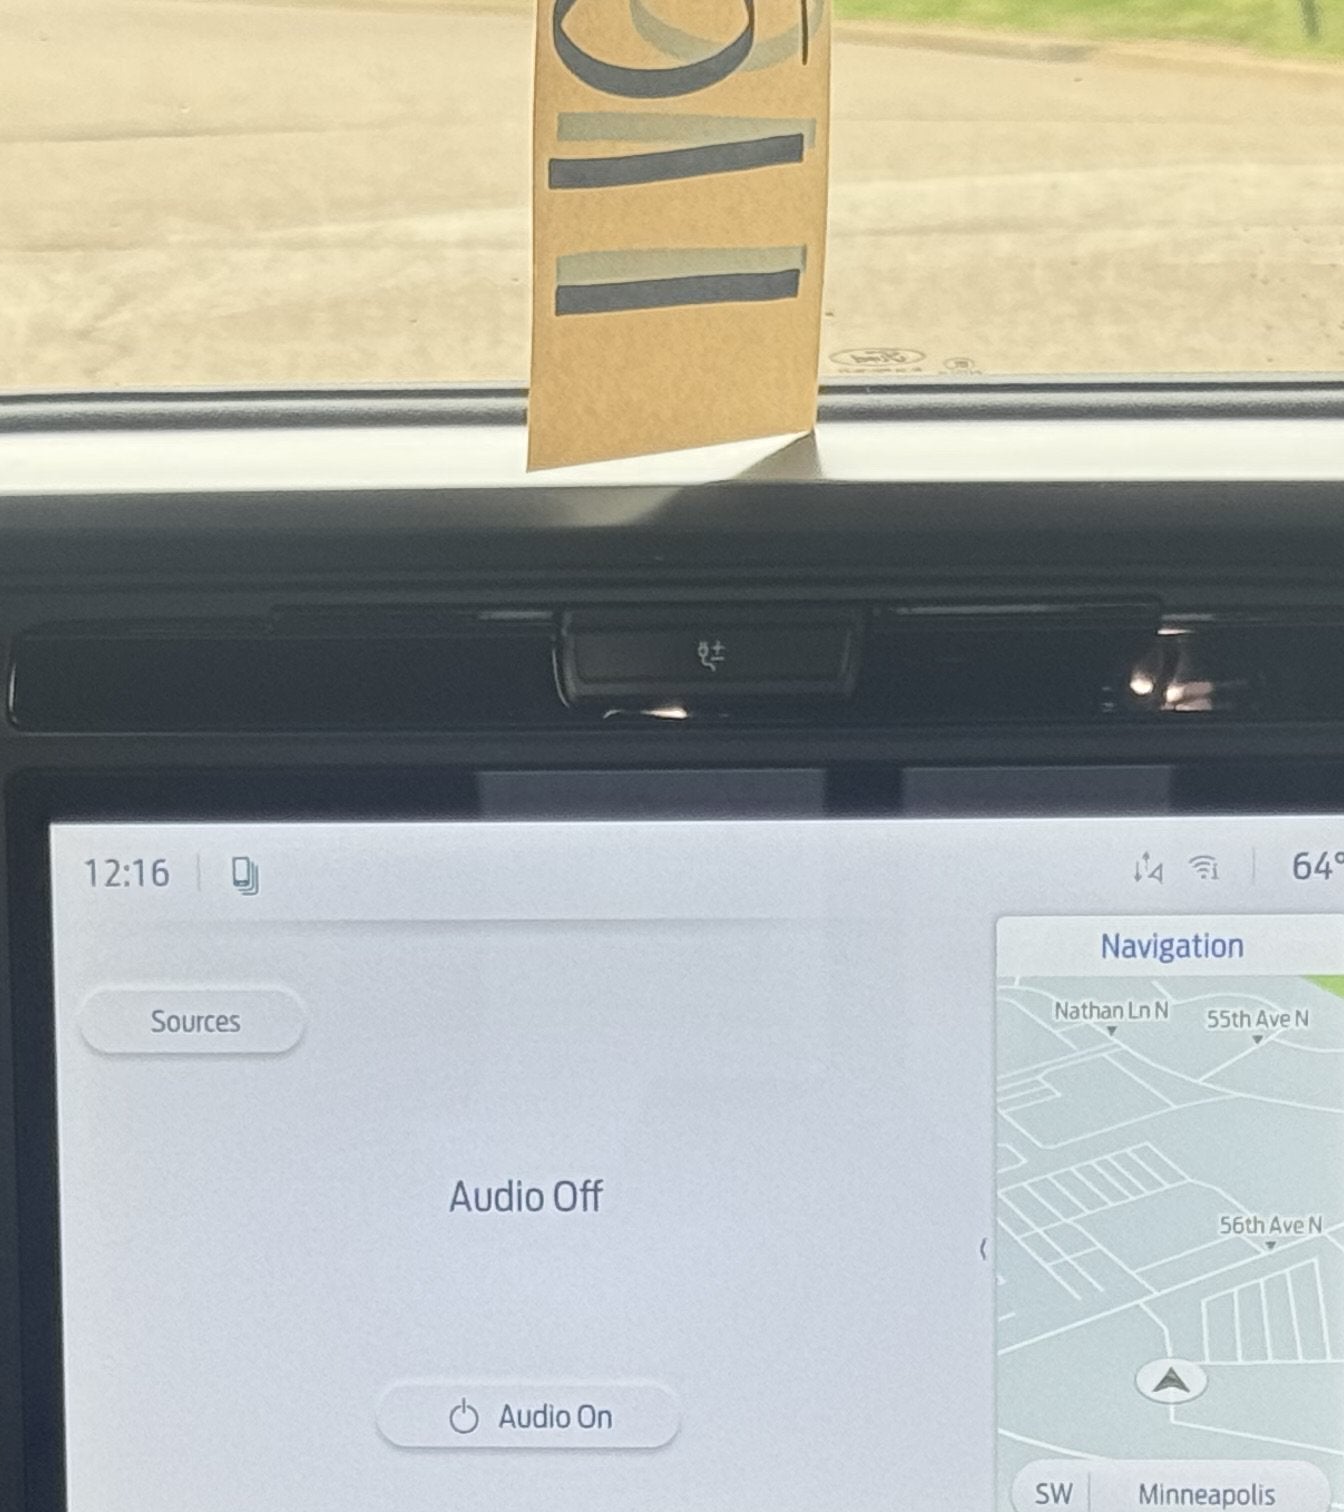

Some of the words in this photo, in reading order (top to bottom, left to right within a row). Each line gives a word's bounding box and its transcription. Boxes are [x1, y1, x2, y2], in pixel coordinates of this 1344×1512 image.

[85, 857, 170, 888] 12:16
[1101, 932, 1245, 963] Navigation
[150, 1009, 241, 1034] Sources
[1054, 1001, 1124, 1020] Nathan
[1127, 1002, 1151, 1019] Ln
[1154, 1001, 1169, 1019] N
[1207, 1010, 1251, 1029] 55th
[1255, 1010, 1291, 1028] Ave
[1294, 1009, 1309, 1027] N
[449, 1179, 545, 1213] Audio
[553, 1178, 604, 1212] Off
[1219, 1216, 1265, 1235] 56th
[1269, 1216, 1305, 1234] Ave
[1309, 1215, 1323, 1233] N
[498, 1403, 571, 1430] Audio
[576, 1404, 613, 1430] On
[1035, 1483, 1073, 1505] SW
[1138, 1483, 1276, 1510] Minneapolis
